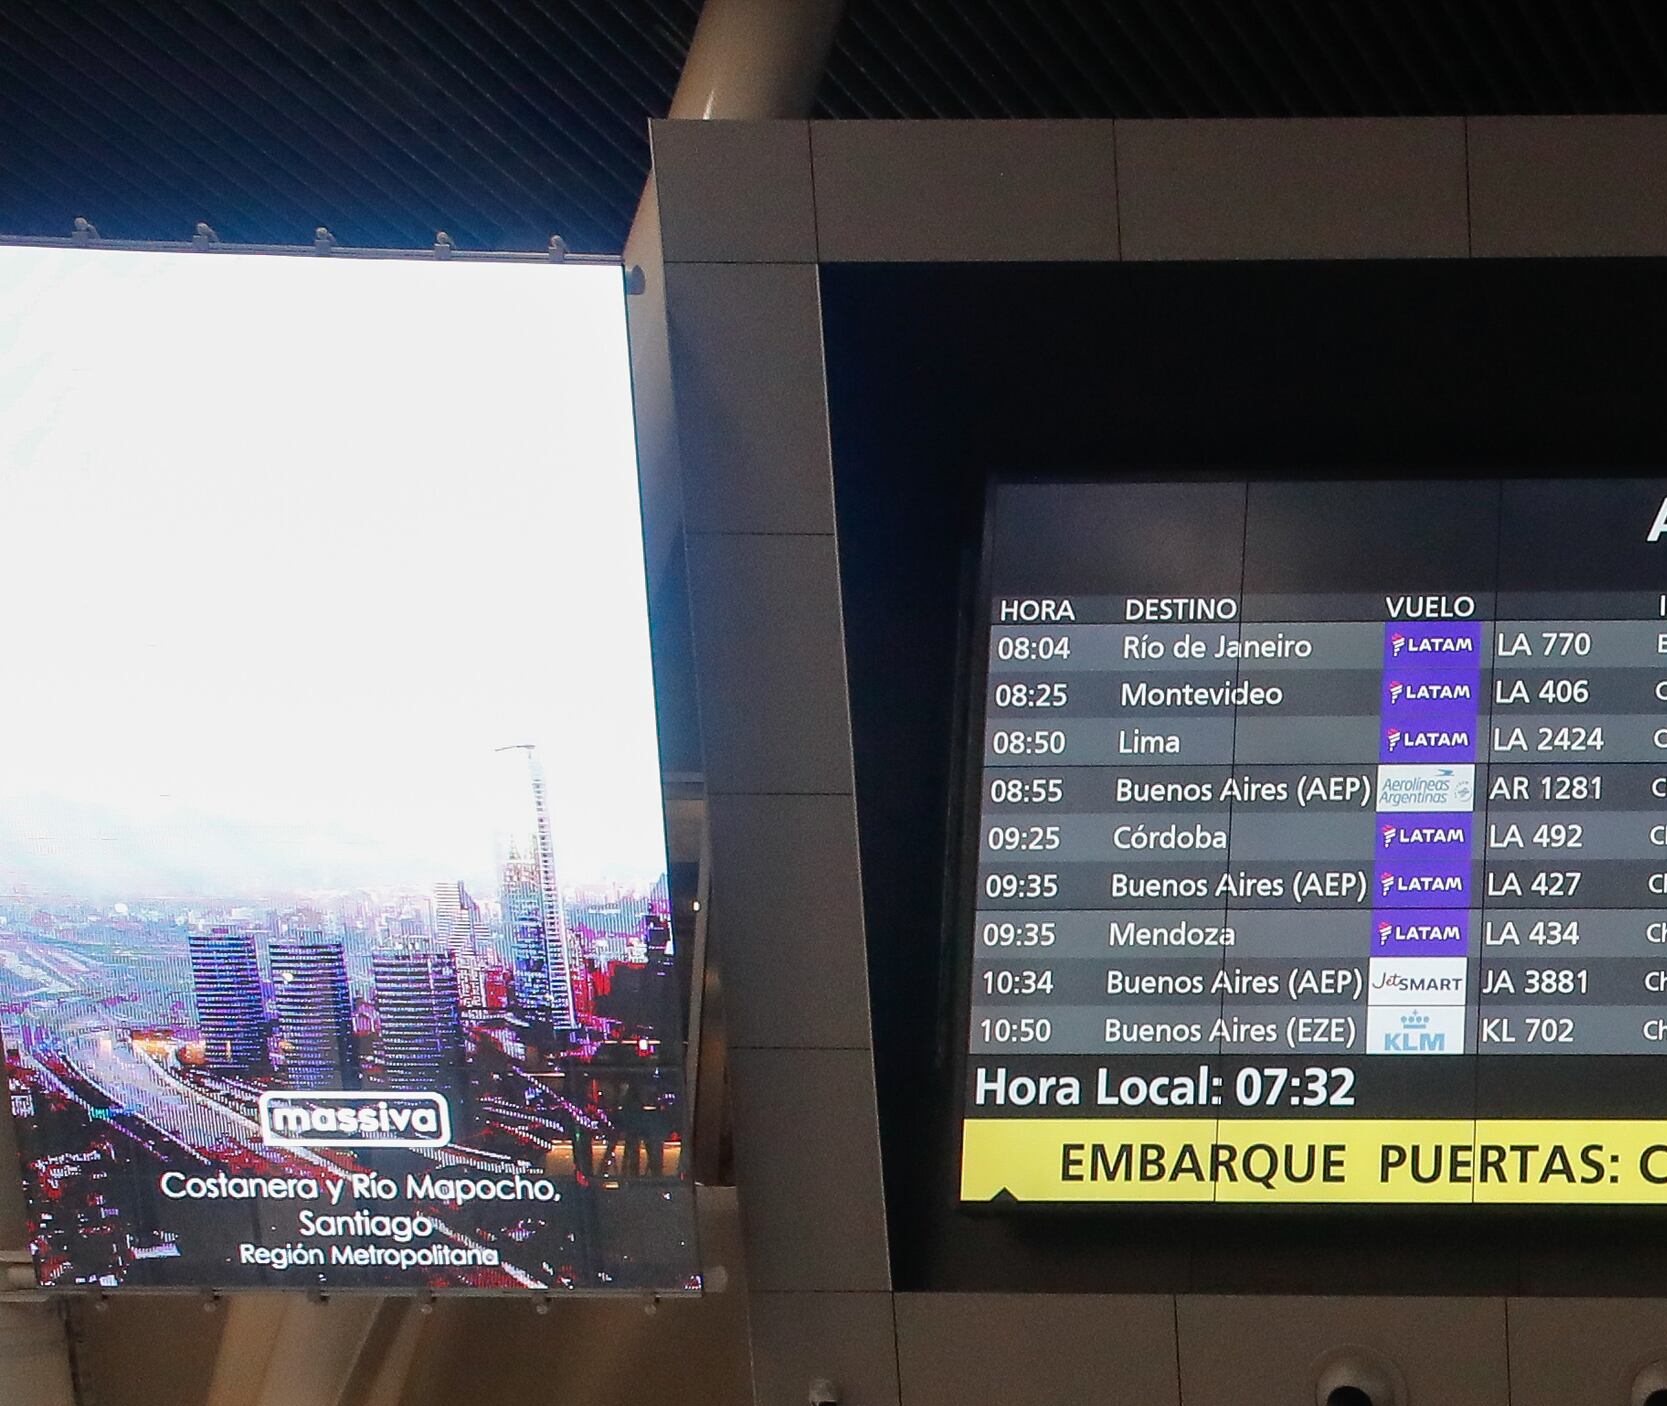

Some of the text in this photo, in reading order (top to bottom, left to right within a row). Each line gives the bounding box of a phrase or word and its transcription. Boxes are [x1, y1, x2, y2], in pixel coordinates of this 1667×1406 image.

[1000, 599, 1076, 621] HORA
[1125, 598, 1237, 620] DESTINO
[1385, 596, 1475, 618] VUELO
[998, 636, 1071, 660] 08:04
[1123, 634, 1165, 659] Río
[1173, 633, 1207, 659] de
[1214, 632, 1312, 658] Janeiro
[1408, 638, 1473, 652] LATAM
[1497, 632, 1532, 656] LA
[1542, 632, 1591, 656] 770
[980, 1018, 1051, 1043] 10:50
[1105, 1018, 1202, 1042] Buenos
[1208, 1016, 1278, 1042] Aires
[1286, 1016, 1356, 1049] (EZE)
[1384, 1033, 1445, 1052] KLM
[1482, 1018, 1516, 1043] KL
[1525, 1018, 1574, 1043] 702
[975, 1065, 1355, 1106] Hora Local: 07:32
[271, 1102, 439, 1135] massiva
[1060, 1142, 1347, 1183] EMBARQUE
[1380, 1143, 1619, 1184] PUERTAS:
[160, 1171, 561, 1206] Costanera y Río Mapocho,
[298, 1210, 434, 1242] Santiago
[240, 1244, 500, 1271] Región Metropolitana
